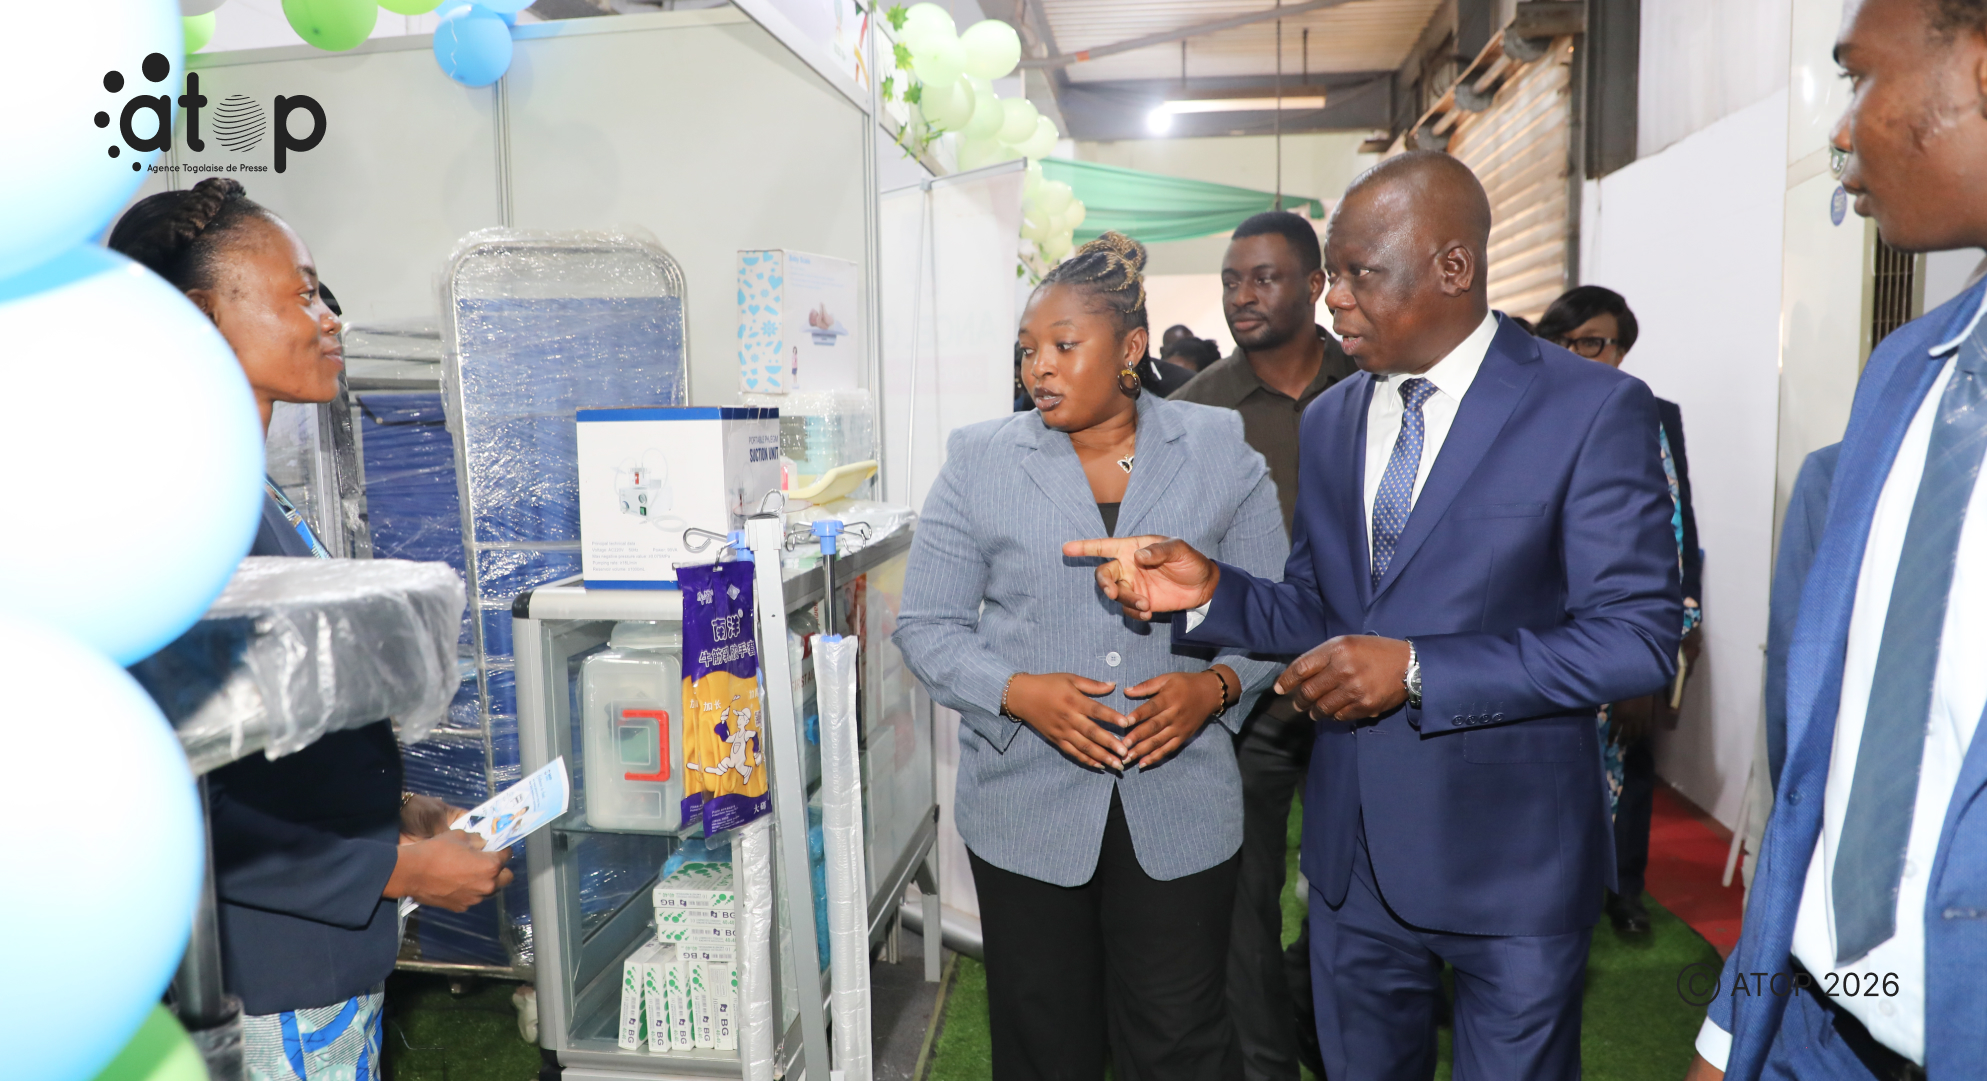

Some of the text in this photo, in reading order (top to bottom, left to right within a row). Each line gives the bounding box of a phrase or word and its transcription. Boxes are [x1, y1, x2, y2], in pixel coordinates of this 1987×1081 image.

[750, 447, 768, 462] SUCTION
[721, 1019, 729, 1036] BG
[628, 1030, 635, 1043] BG
[657, 1032, 664, 1046] BG
[680, 1031, 687, 1044] BG
[703, 1028, 710, 1042] BG
